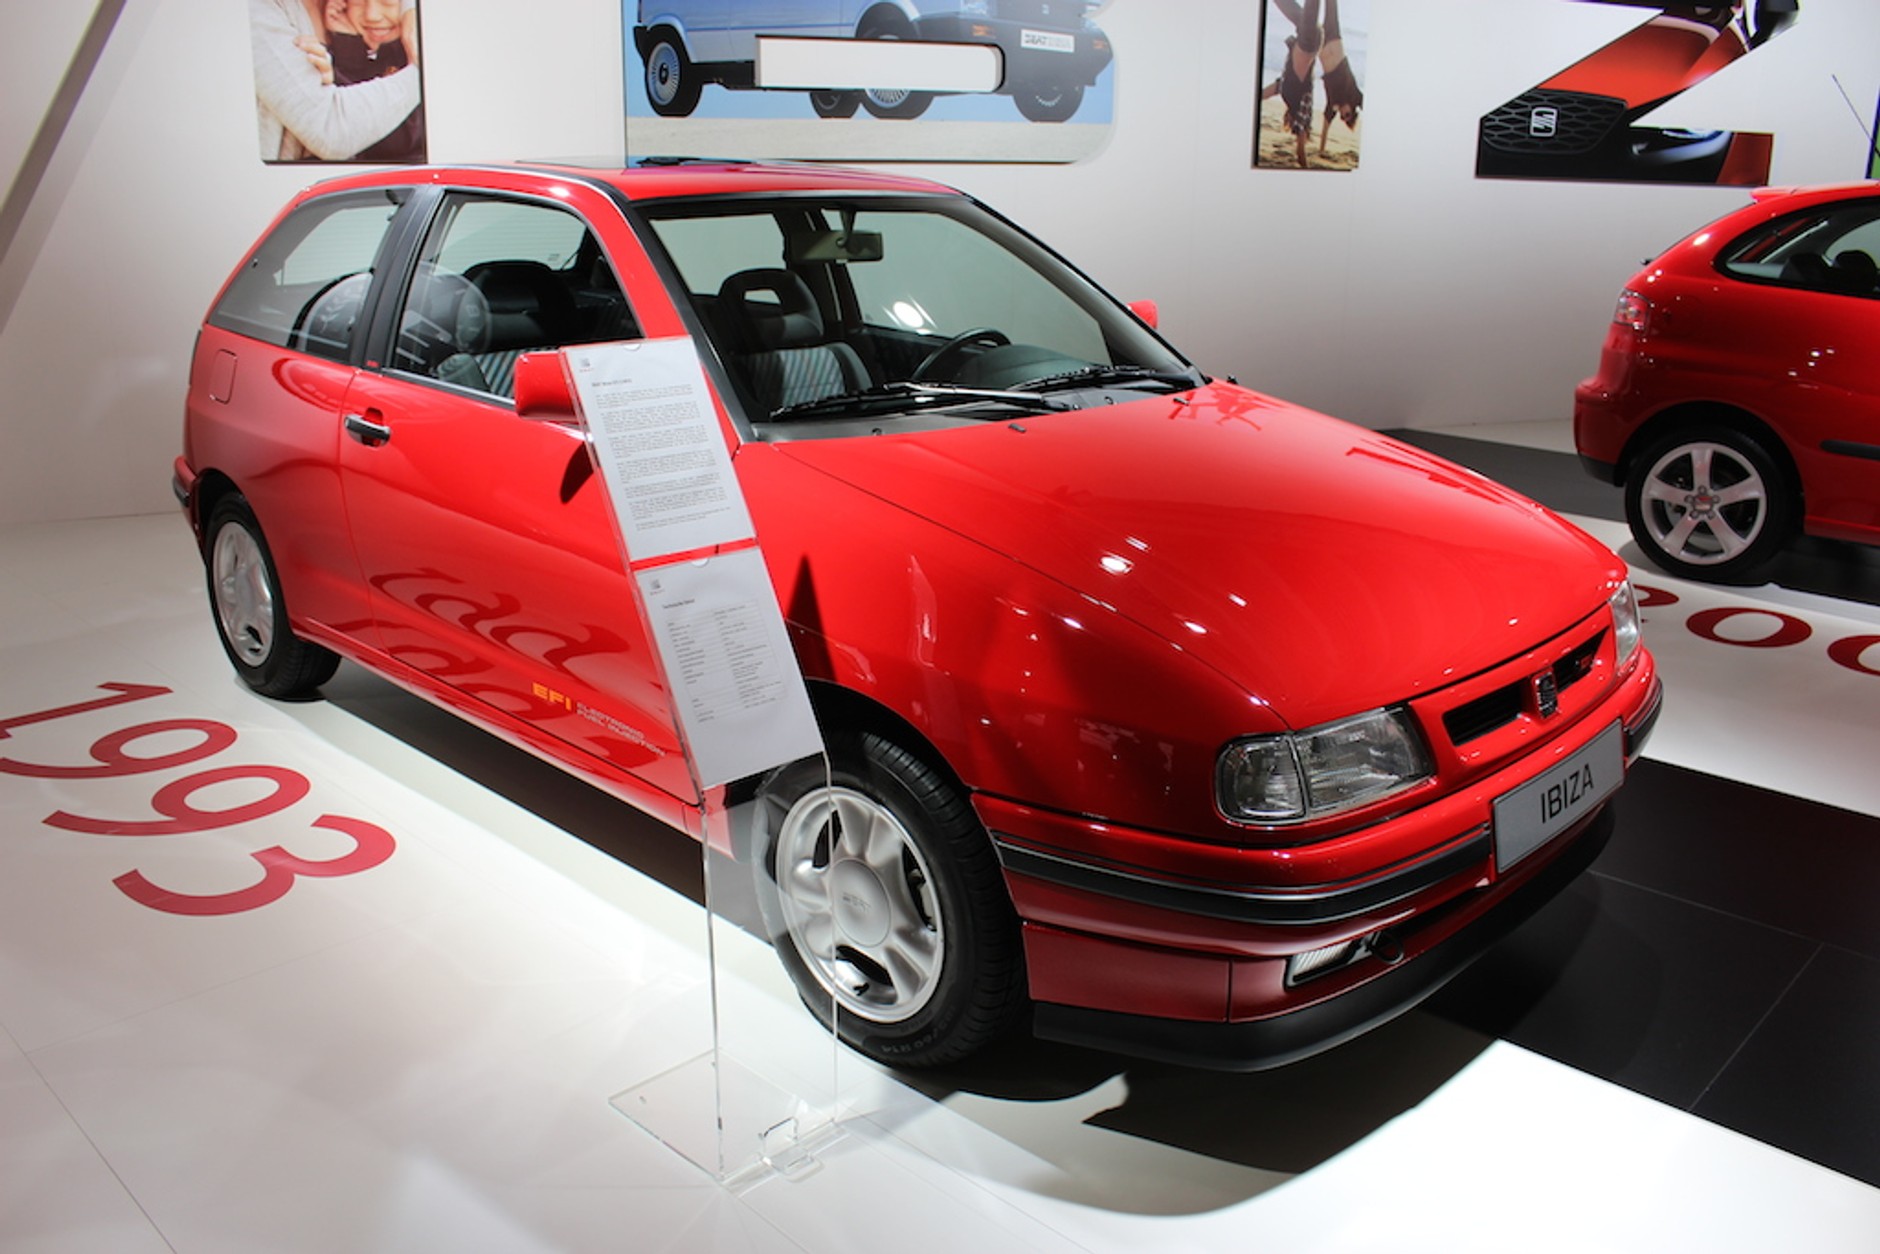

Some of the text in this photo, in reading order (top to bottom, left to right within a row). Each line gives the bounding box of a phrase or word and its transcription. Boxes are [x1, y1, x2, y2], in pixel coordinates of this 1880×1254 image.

[532, 682, 572, 711] EFI
[0, 681, 397, 917] 1993
[1540, 763, 1595, 824] IBIZA
